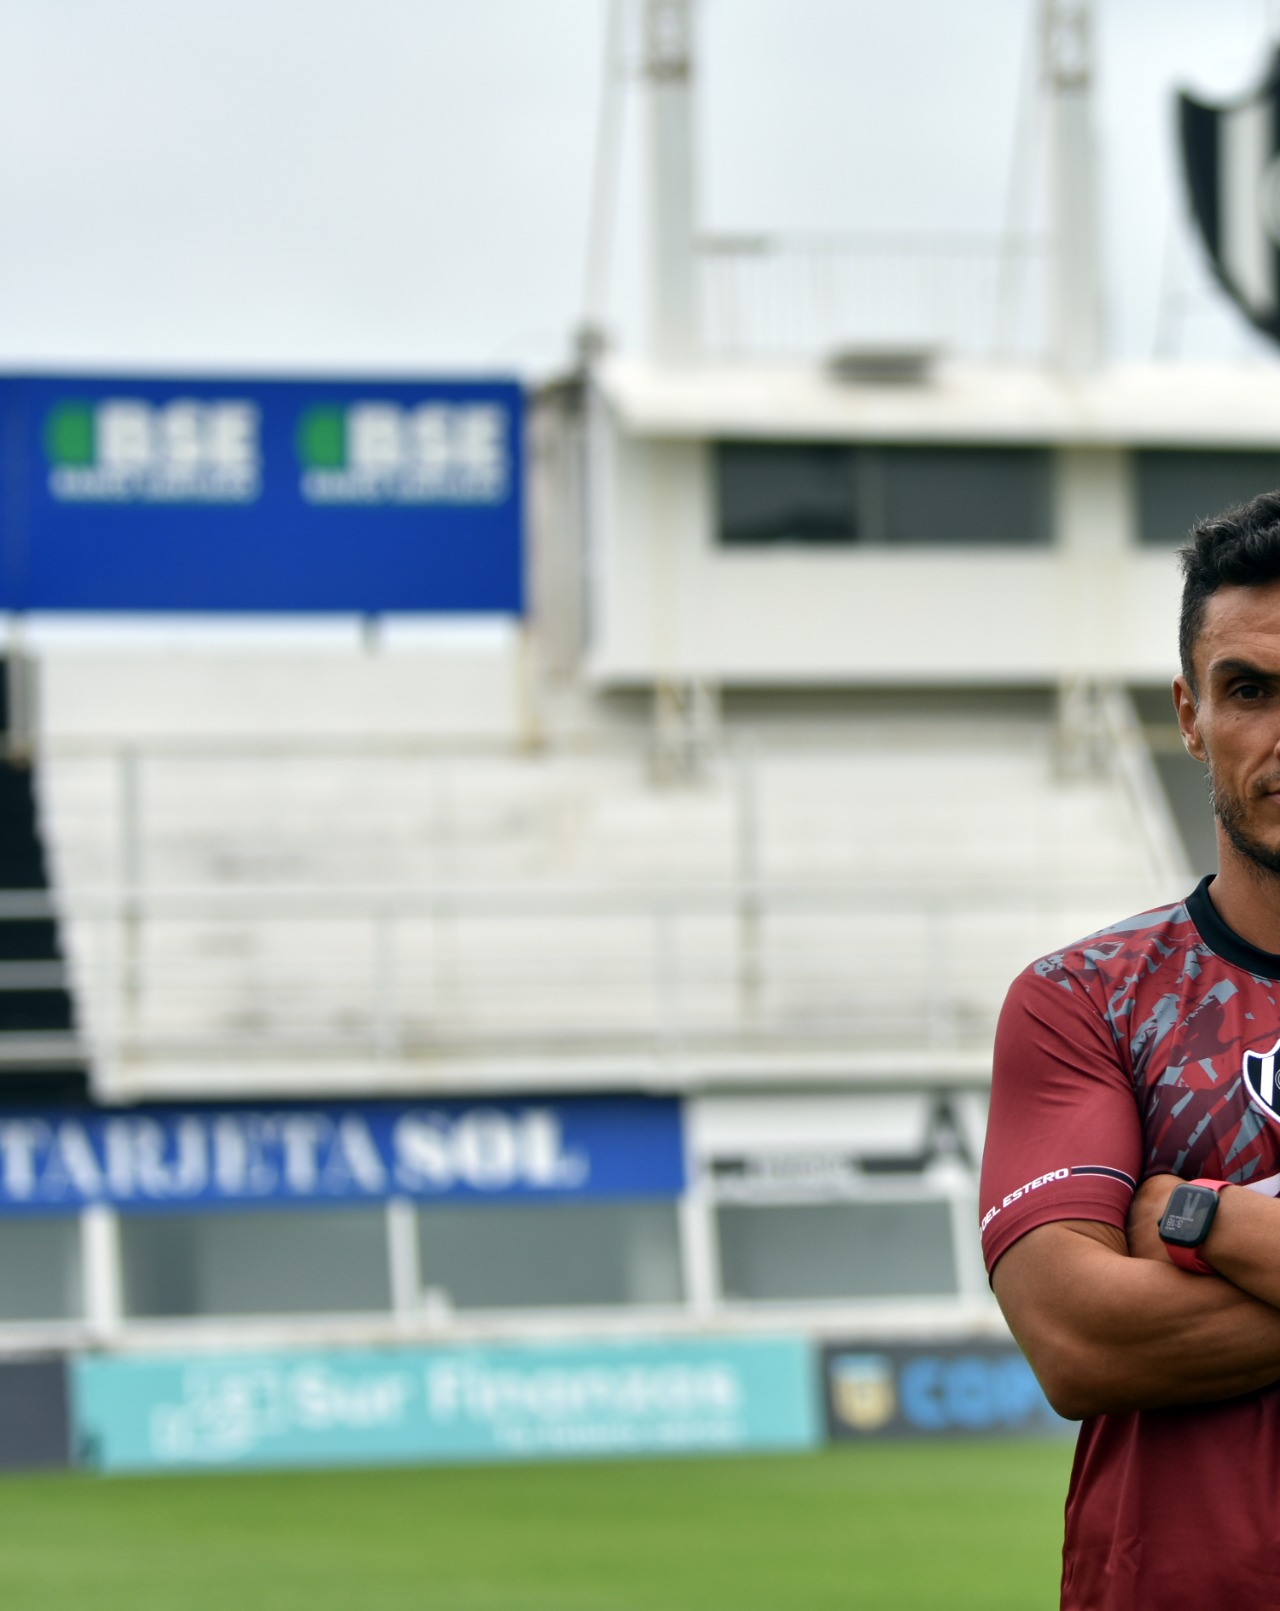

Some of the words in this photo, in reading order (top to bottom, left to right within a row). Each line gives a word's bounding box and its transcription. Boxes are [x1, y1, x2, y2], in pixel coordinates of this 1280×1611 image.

[0, 1112, 388, 1198] TARJETA
[393, 1106, 590, 1192] SOL
[1003, 1168, 1069, 1208] ESTERO
